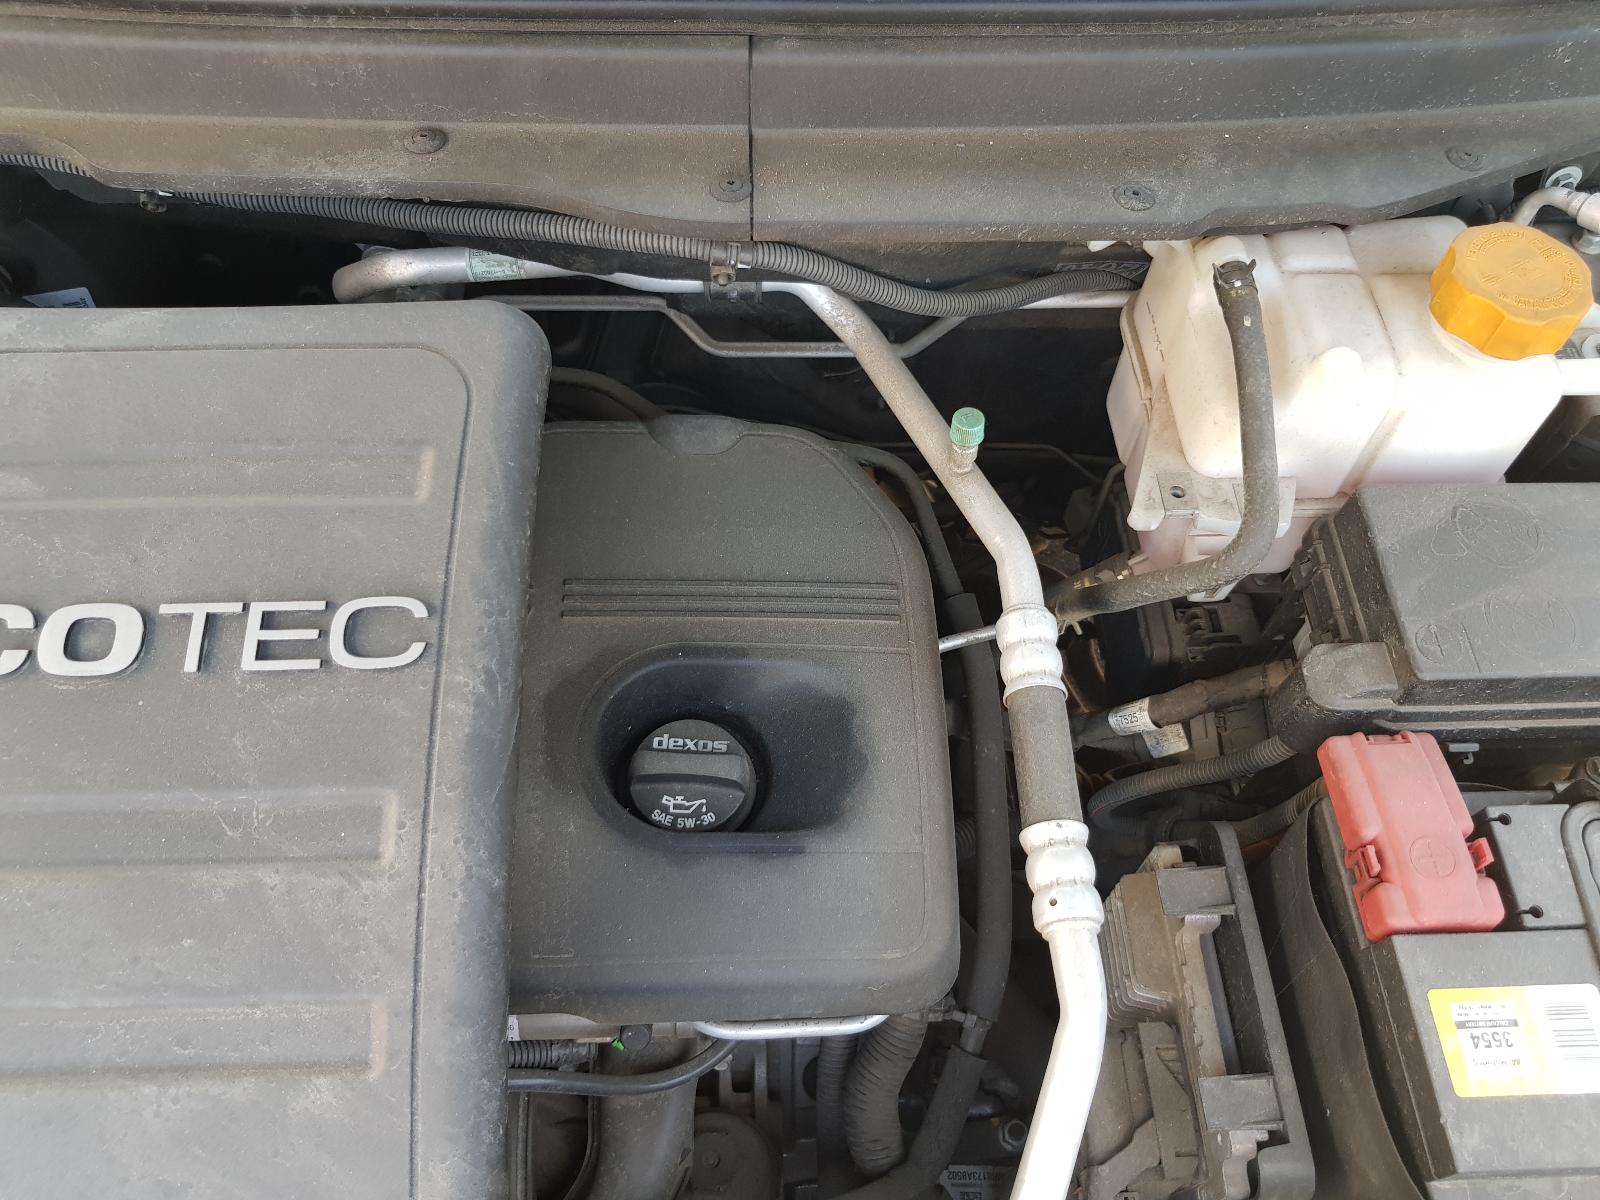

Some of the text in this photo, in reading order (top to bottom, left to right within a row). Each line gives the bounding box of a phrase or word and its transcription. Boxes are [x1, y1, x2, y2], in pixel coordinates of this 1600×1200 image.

[1118, 712, 1139, 725] 7525
[652, 733, 730, 753] dexos
[651, 809, 716, 829] SAE 5W-30
[1470, 1031, 1514, 1050] 3554
